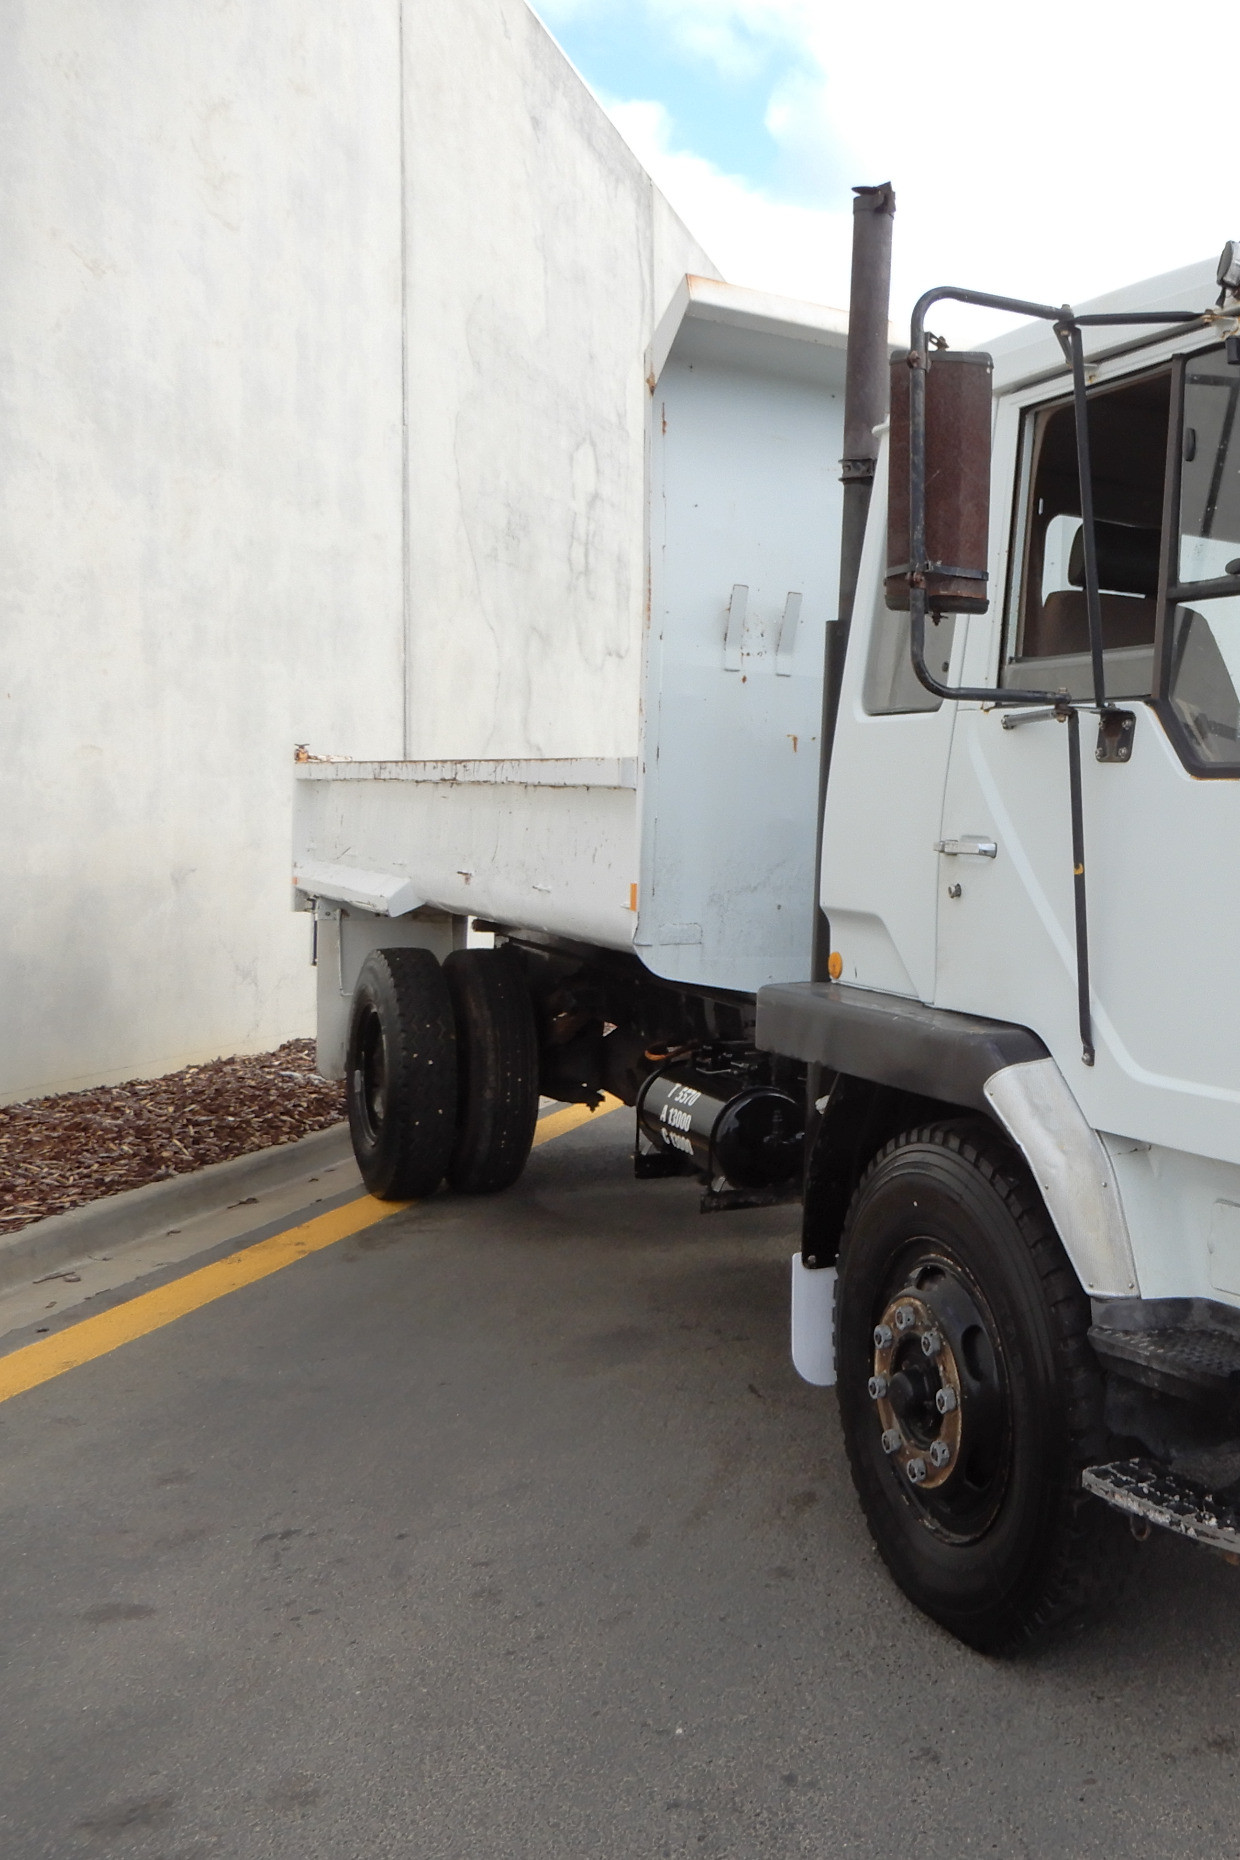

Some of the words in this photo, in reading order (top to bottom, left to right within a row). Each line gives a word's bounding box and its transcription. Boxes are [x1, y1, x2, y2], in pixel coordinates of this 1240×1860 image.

[668, 1083, 681, 1098] T
[660, 1104, 669, 1122] A
[668, 1107, 692, 1132] 13000
[661, 1127, 671, 1145] C
